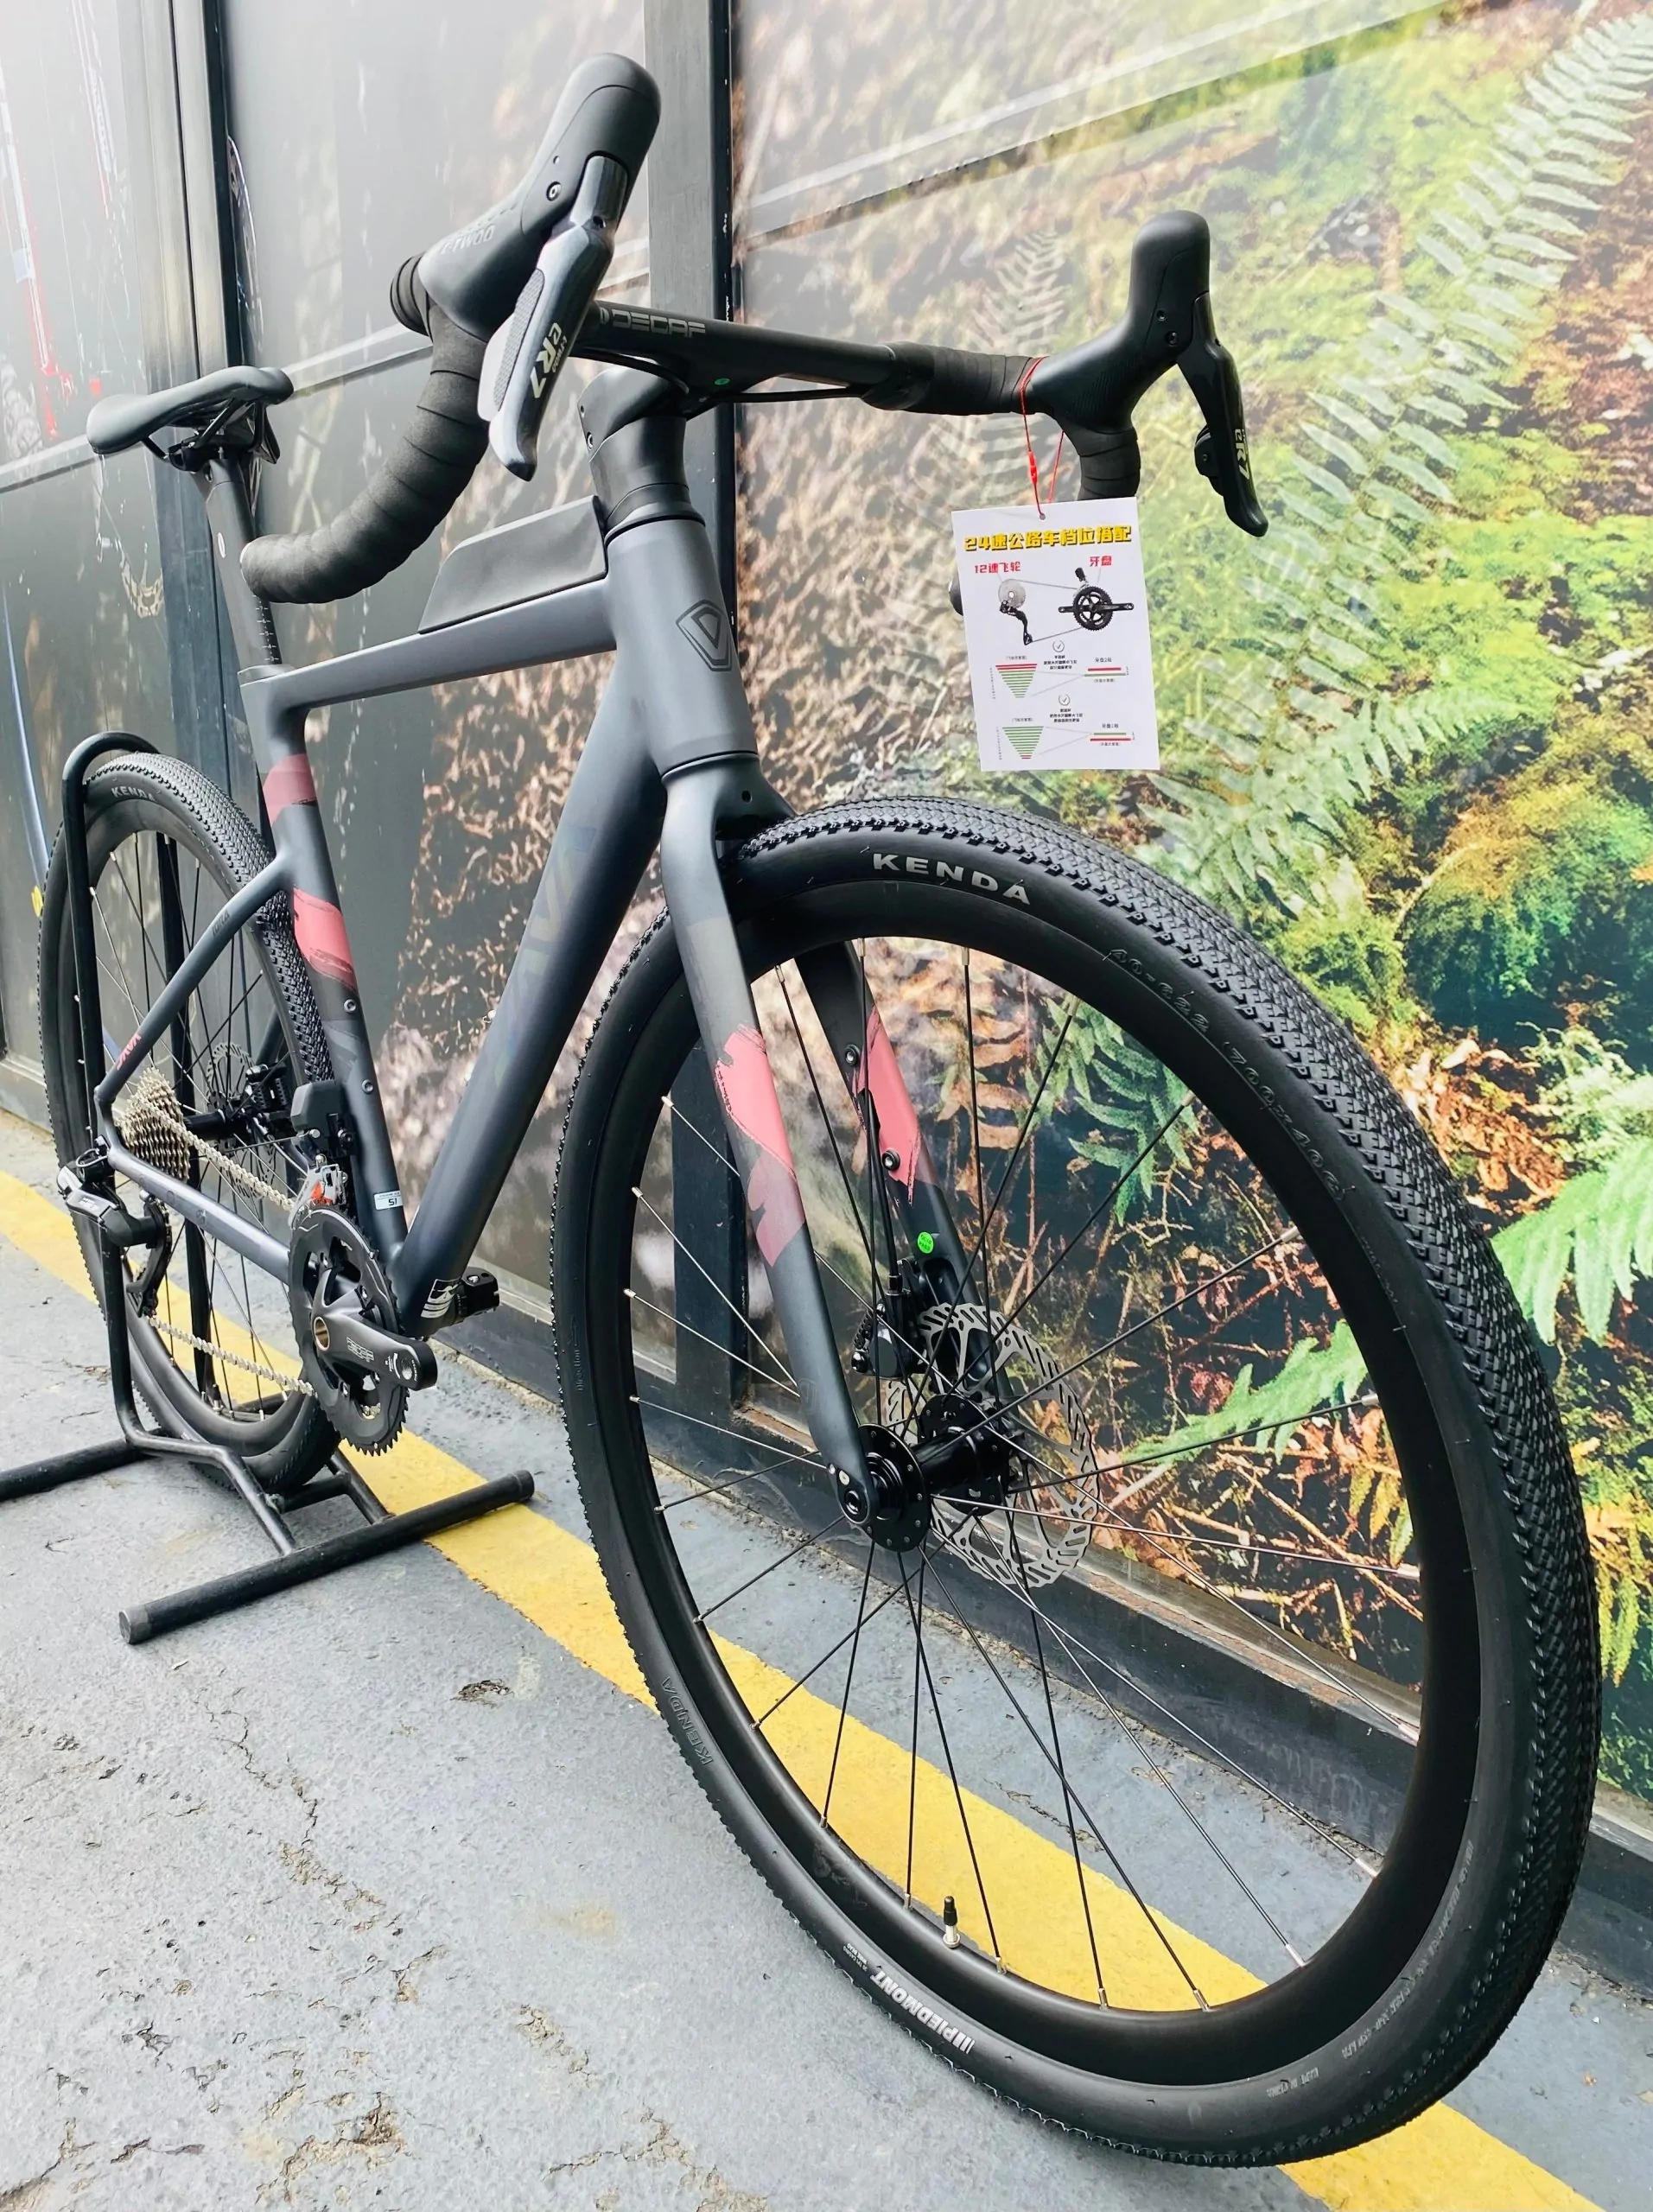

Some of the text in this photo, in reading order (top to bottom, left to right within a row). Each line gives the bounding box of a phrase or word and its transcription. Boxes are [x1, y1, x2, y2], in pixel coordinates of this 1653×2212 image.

[964, 525, 1132, 552] 24速公路车档位搭配
[974, 562, 1022, 574] 12速飞轮
[1090, 556, 1113, 567] 牙盘
[873, 853, 1031, 906] KENDA
[661, 1675, 715, 1766] KENDA
[869, 1970, 959, 2043] PIEDMONT
